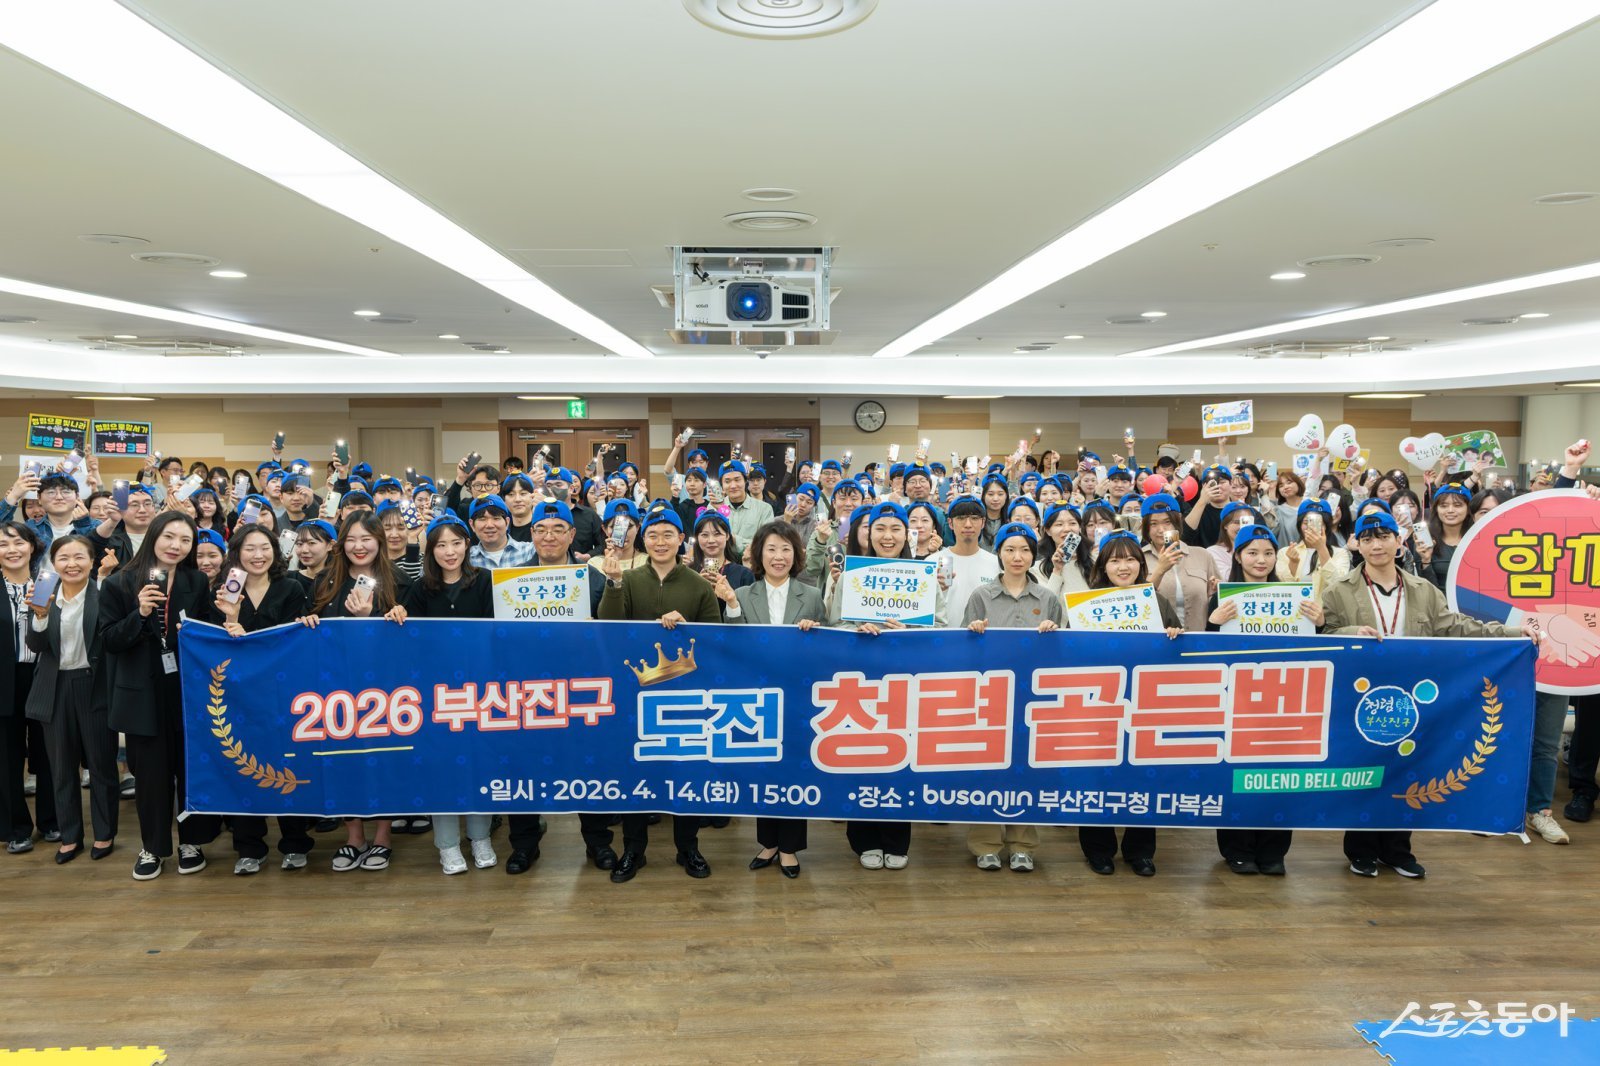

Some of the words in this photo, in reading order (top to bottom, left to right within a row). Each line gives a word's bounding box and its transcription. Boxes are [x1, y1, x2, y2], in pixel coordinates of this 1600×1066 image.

[516, 583, 567, 600] 우수상
[862, 574, 919, 592] 최우수상
[514, 605, 574, 618] 200,000원
[861, 596, 919, 610] 300,000원
[1092, 603, 1139, 621] 우수상
[1242, 601, 1293, 616] 장려상
[291, 684, 423, 742] 2026
[432, 677, 616, 732] 부산진구
[633, 687, 785, 763] 도전
[810, 669, 1015, 774] 청렴
[1025, 660, 1335, 768] 골든벨
[1366, 716, 1411, 728] 부산진구
[1244, 773, 1300, 790] GOLEND
[1305, 772, 1338, 789] BELL
[1341, 770, 1374, 787] QUIZ
[552, 779, 627, 800] 2026.
[632, 779, 657, 799] 4.
[749, 783, 822, 806] 15:00
[923, 784, 1033, 812] busanjin
[1037, 790, 1150, 814] 부산진구청
[1156, 793, 1223, 816] 다복실
